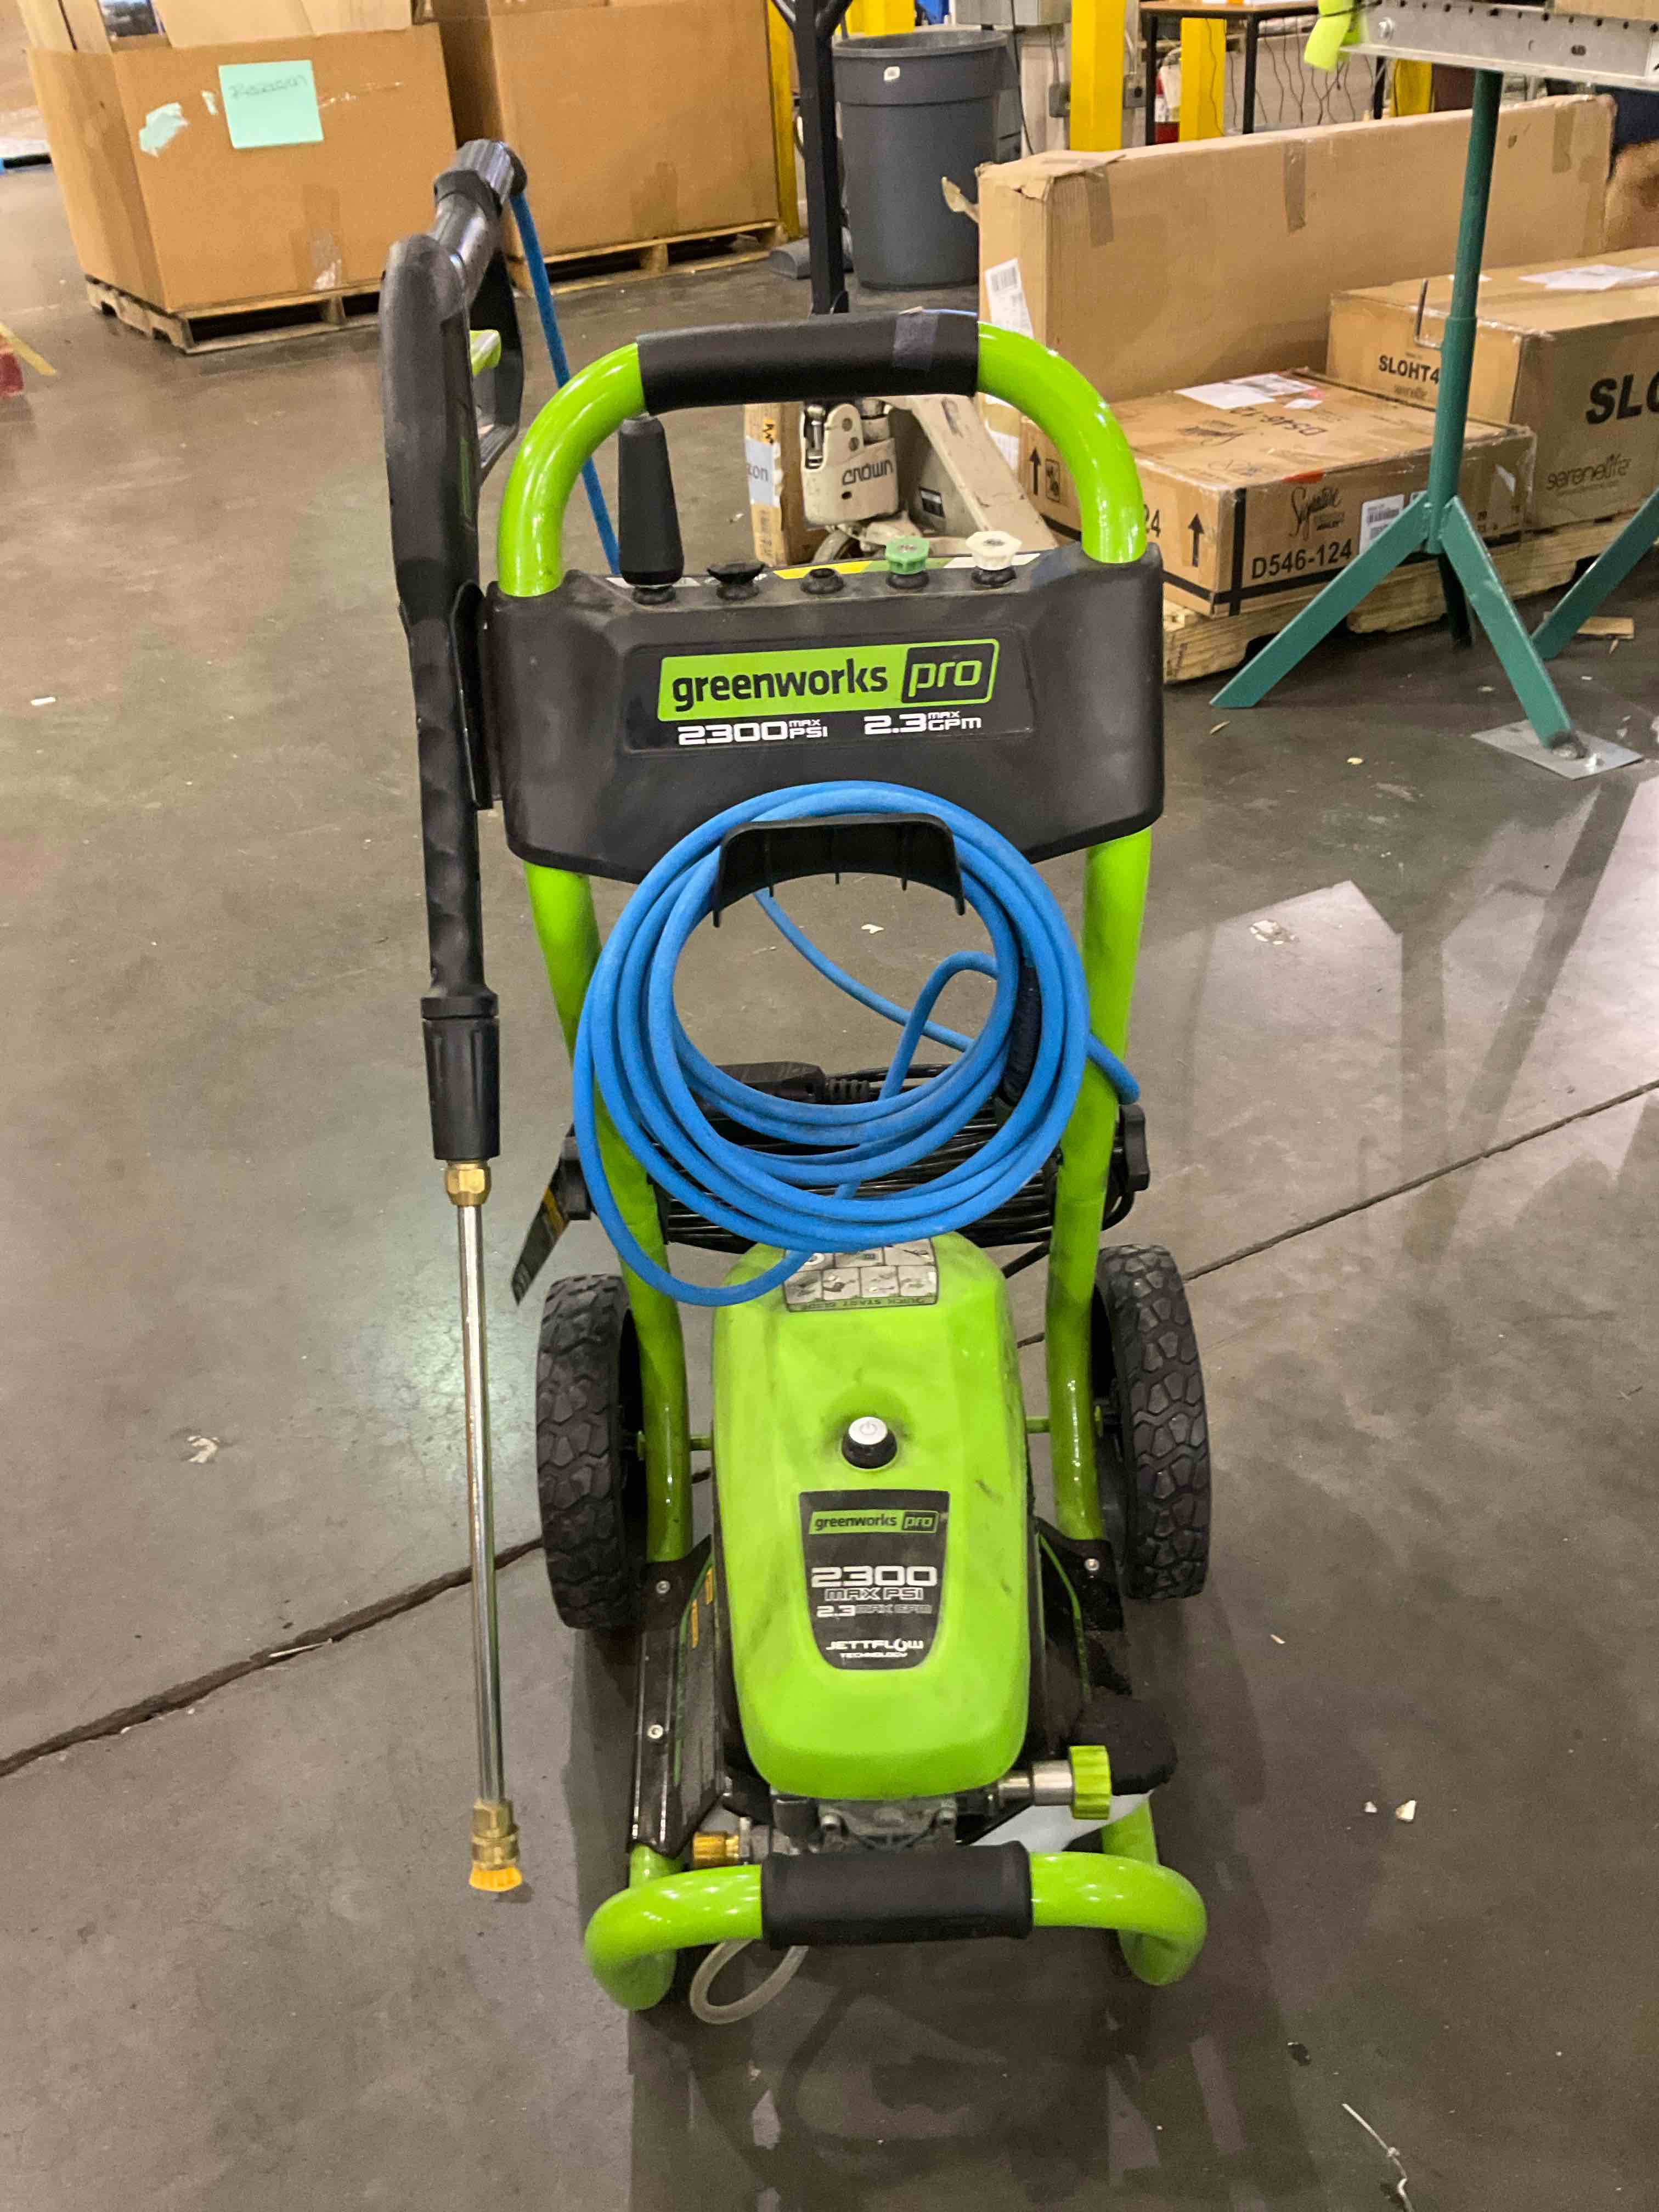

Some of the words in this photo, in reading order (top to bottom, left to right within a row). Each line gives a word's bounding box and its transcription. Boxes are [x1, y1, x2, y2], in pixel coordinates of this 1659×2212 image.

[1251, 538, 1352, 579] D546-124
[673, 658, 888, 712] greenworks
[907, 659, 983, 697] pro
[677, 721, 788, 746] 2300
[789, 726, 828, 739] PSI
[864, 713, 927, 735] 2.3
[815, 1514, 897, 1531] greenworks
[904, 1516, 934, 1529] pro
[811, 1565, 938, 1588] 2300
[825, 1587, 881, 1601] MAX
[883, 1587, 924, 1601] PSI
[816, 1605, 856, 1618] 2.3
